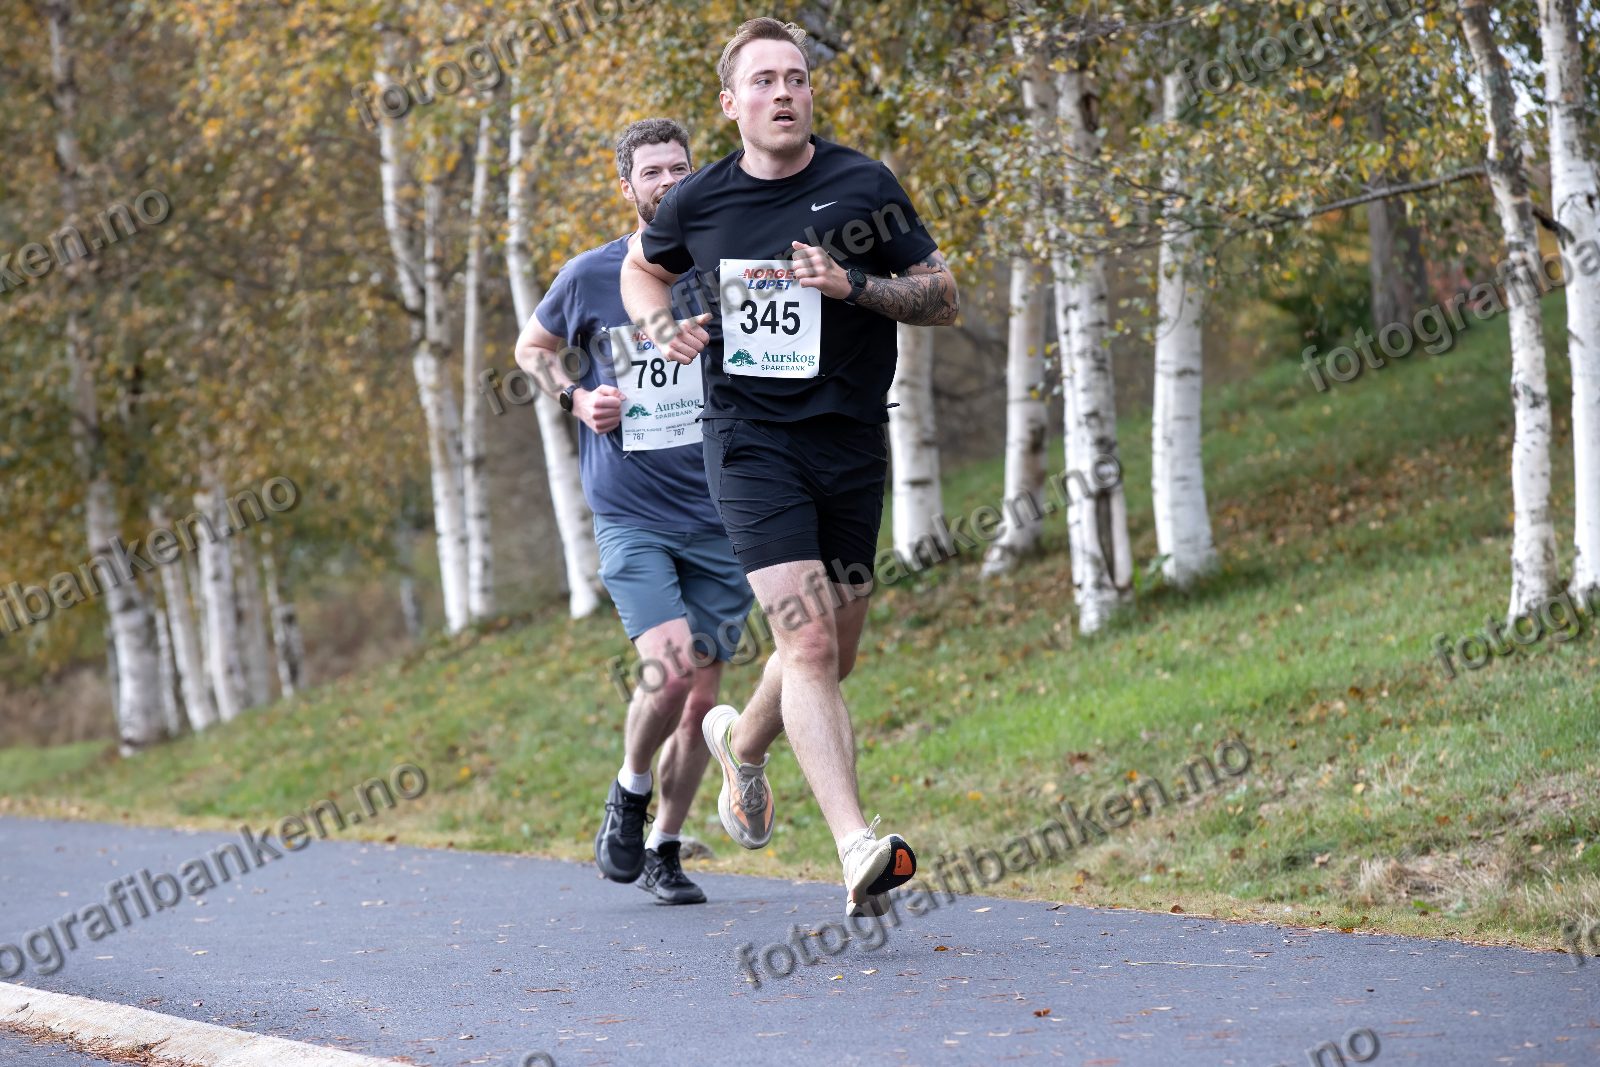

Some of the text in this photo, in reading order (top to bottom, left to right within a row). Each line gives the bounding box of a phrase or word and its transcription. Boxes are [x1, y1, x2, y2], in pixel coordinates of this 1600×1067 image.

[743, 268, 801, 279] NORGE
[747, 279, 794, 290] LØPET
[740, 299, 801, 336] 345
[761, 351, 816, 367] Aurskog
[630, 357, 681, 389] 787
[654, 398, 701, 413] Aurskog
[655, 409, 694, 419] SPAREBANK
[632, 432, 645, 440] 787
[672, 428, 685, 436] 787
